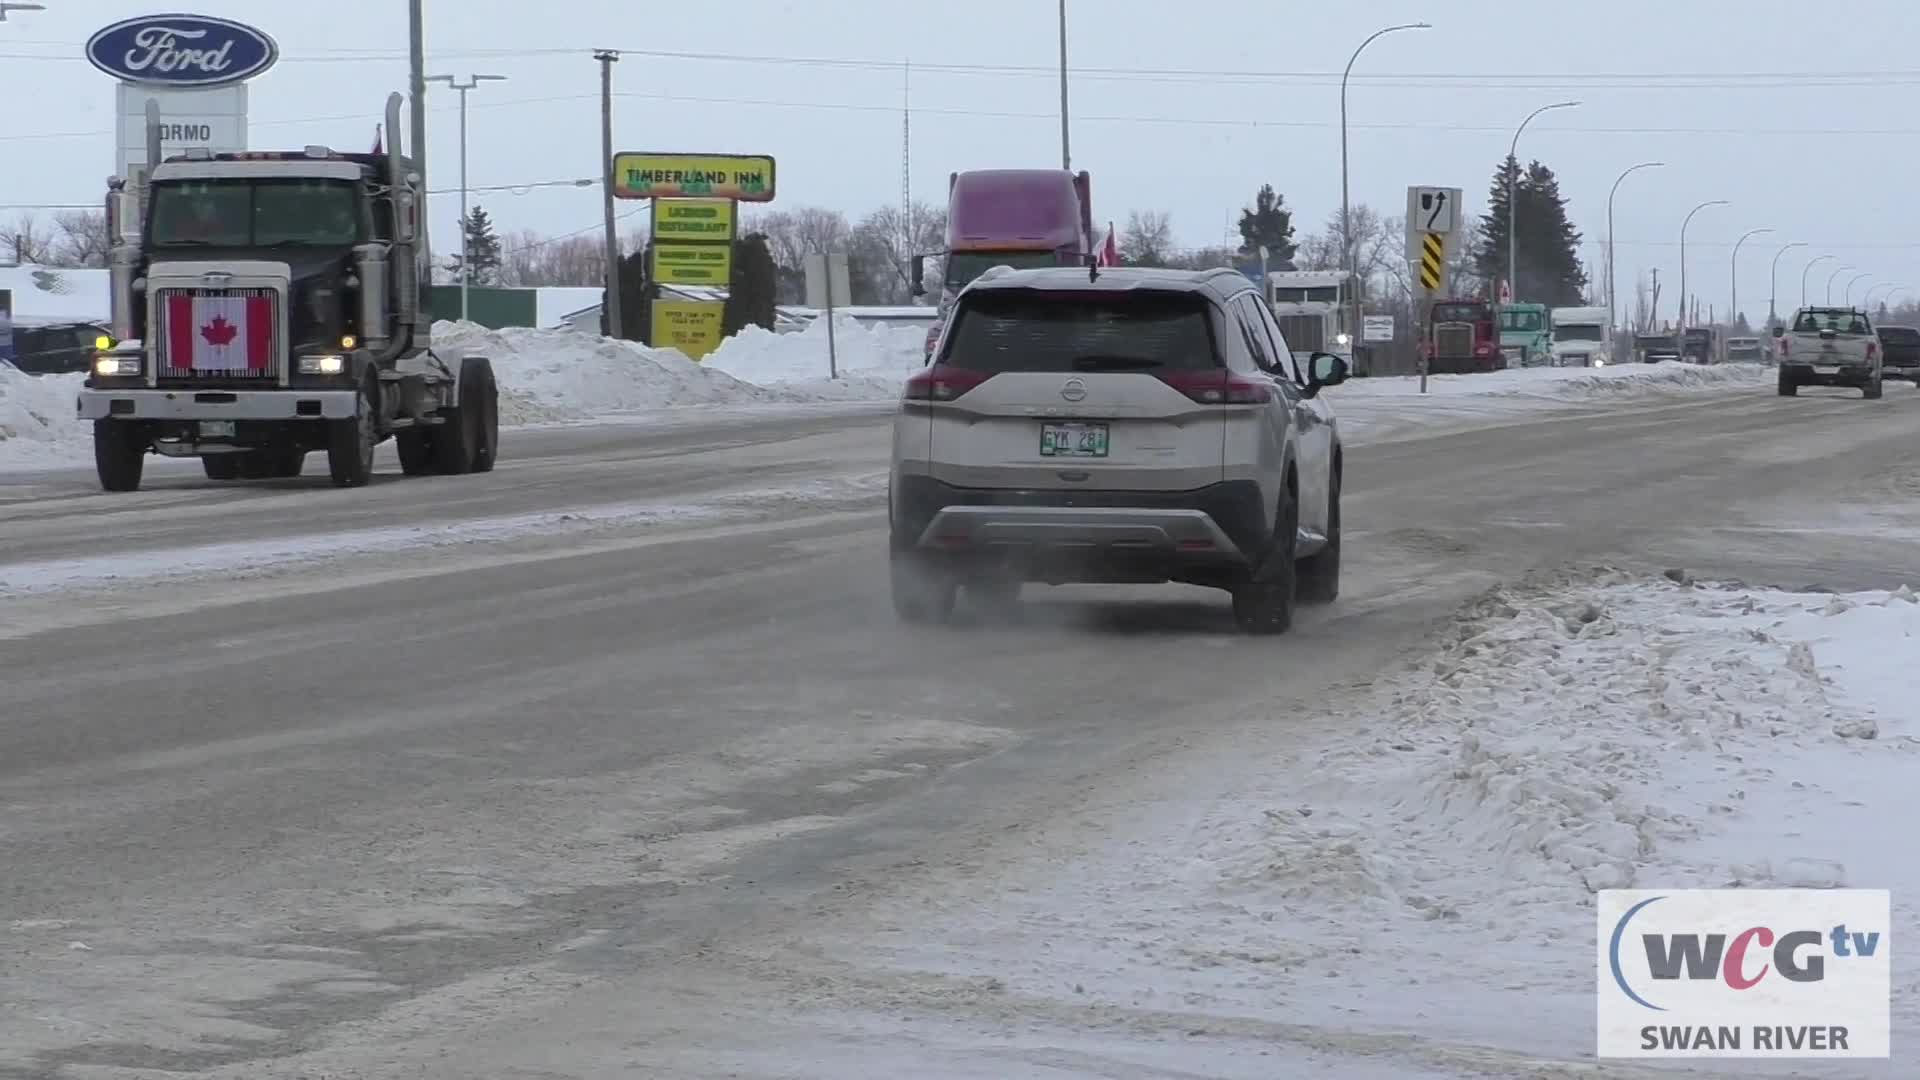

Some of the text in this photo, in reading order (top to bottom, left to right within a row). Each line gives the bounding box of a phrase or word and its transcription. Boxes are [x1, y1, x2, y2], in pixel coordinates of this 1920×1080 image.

[124, 26, 235, 72] Ford
[158, 124, 211, 141] ORMO
[627, 168, 762, 185] TIMBERLAND INN
